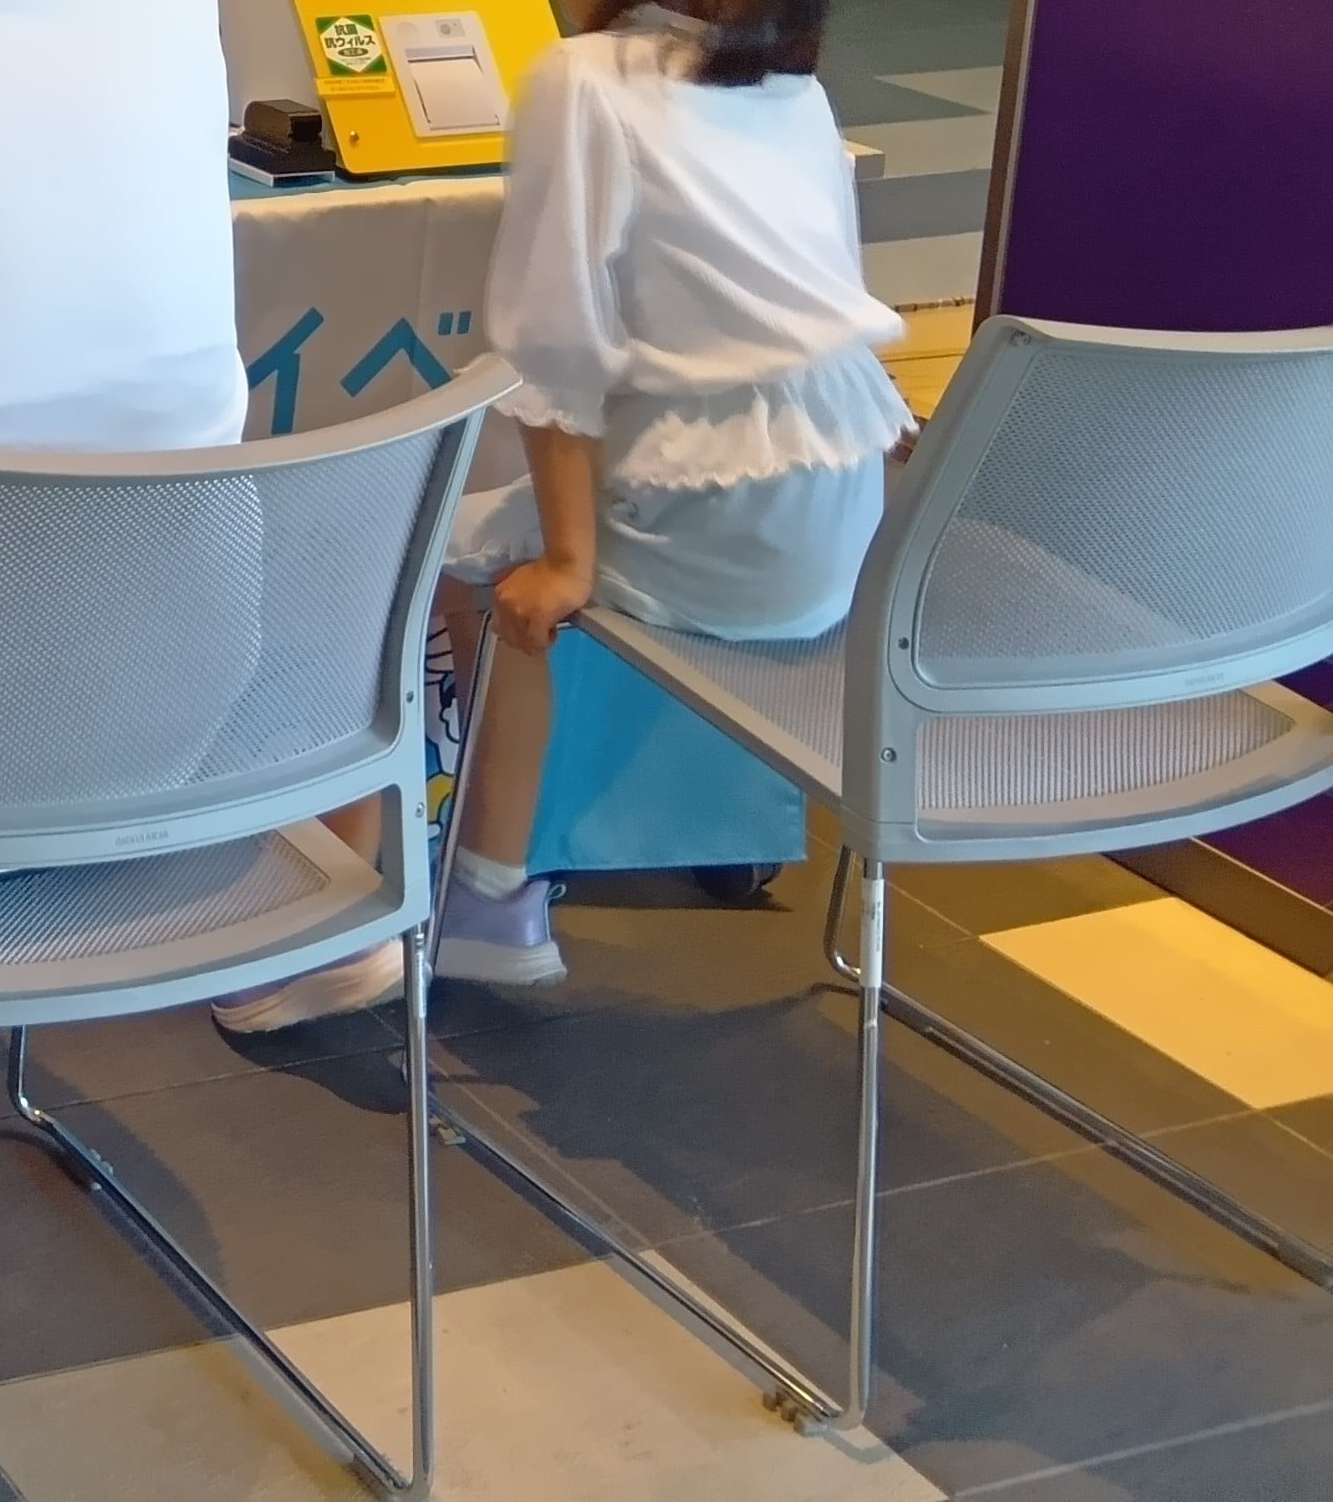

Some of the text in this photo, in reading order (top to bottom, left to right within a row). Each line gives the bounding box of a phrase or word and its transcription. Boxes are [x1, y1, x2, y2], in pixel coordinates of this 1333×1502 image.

[324, 34, 377, 49] 抗ウィルス
